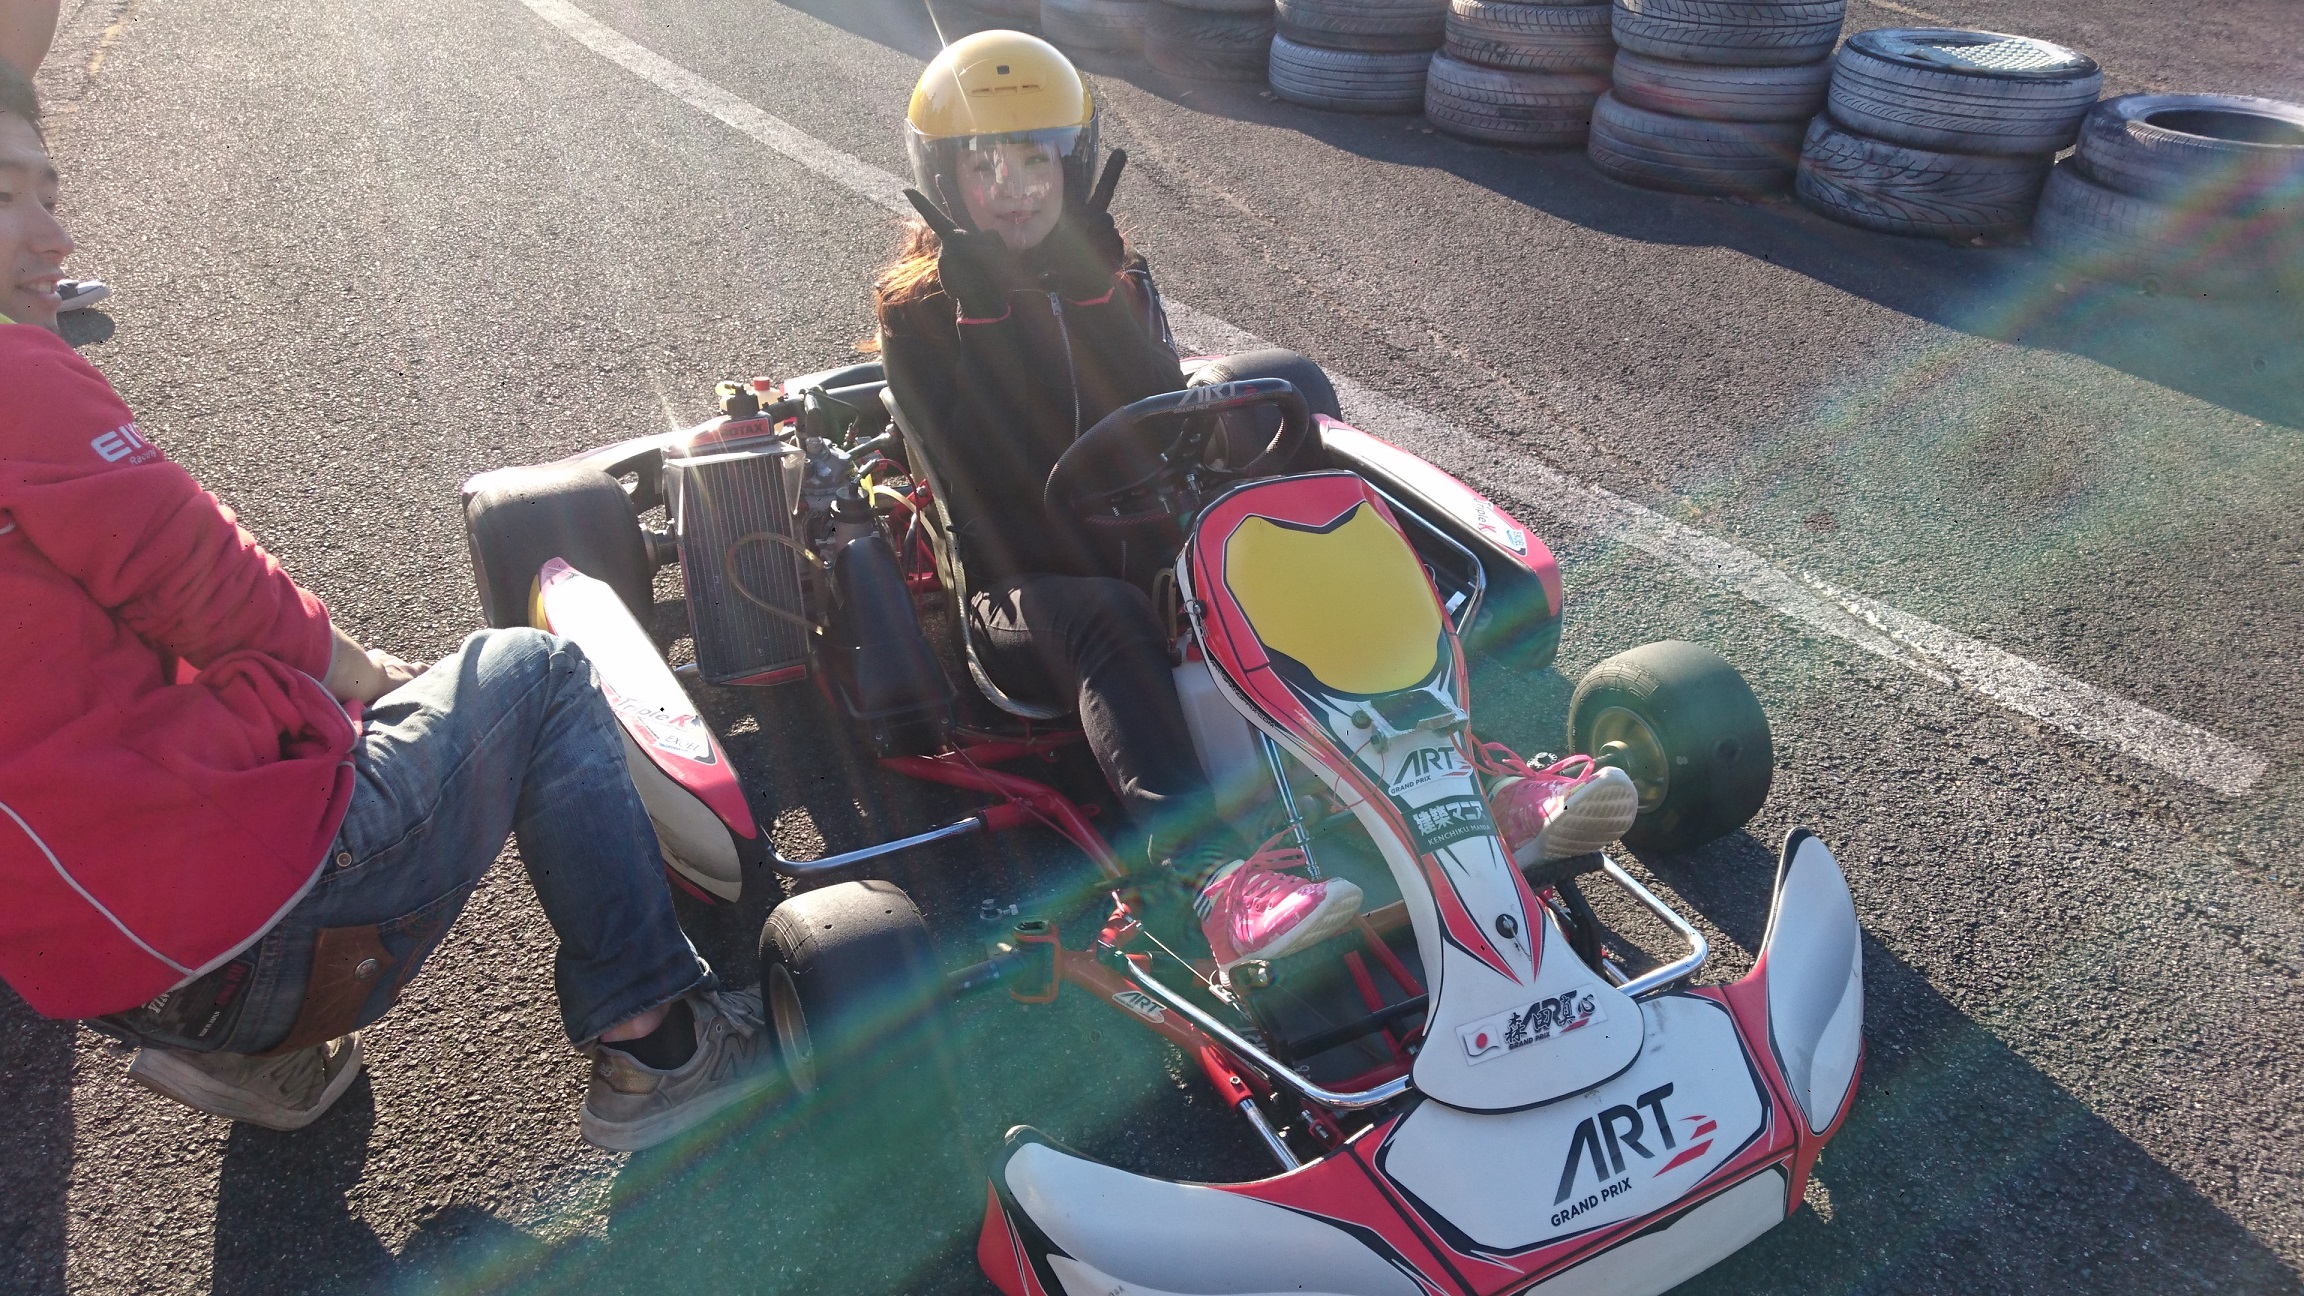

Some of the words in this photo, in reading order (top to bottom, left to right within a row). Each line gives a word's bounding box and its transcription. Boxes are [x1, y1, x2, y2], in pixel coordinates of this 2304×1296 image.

[1393, 747, 1455, 786] ART
[1390, 781, 1415, 794] GRAND
[1415, 774, 1432, 786] PRIX
[1412, 801, 1484, 837] 建築マニア
[1427, 826, 1470, 846] KENCHIKU
[1121, 991, 1163, 1013] ART
[1508, 1036, 1534, 1050] GRAND
[1535, 1031, 1551, 1041] PRIX
[1553, 1081, 1677, 1206] ART
[1551, 1194, 1599, 1227] GRAND
[1600, 1176, 1633, 1203] PRIX
